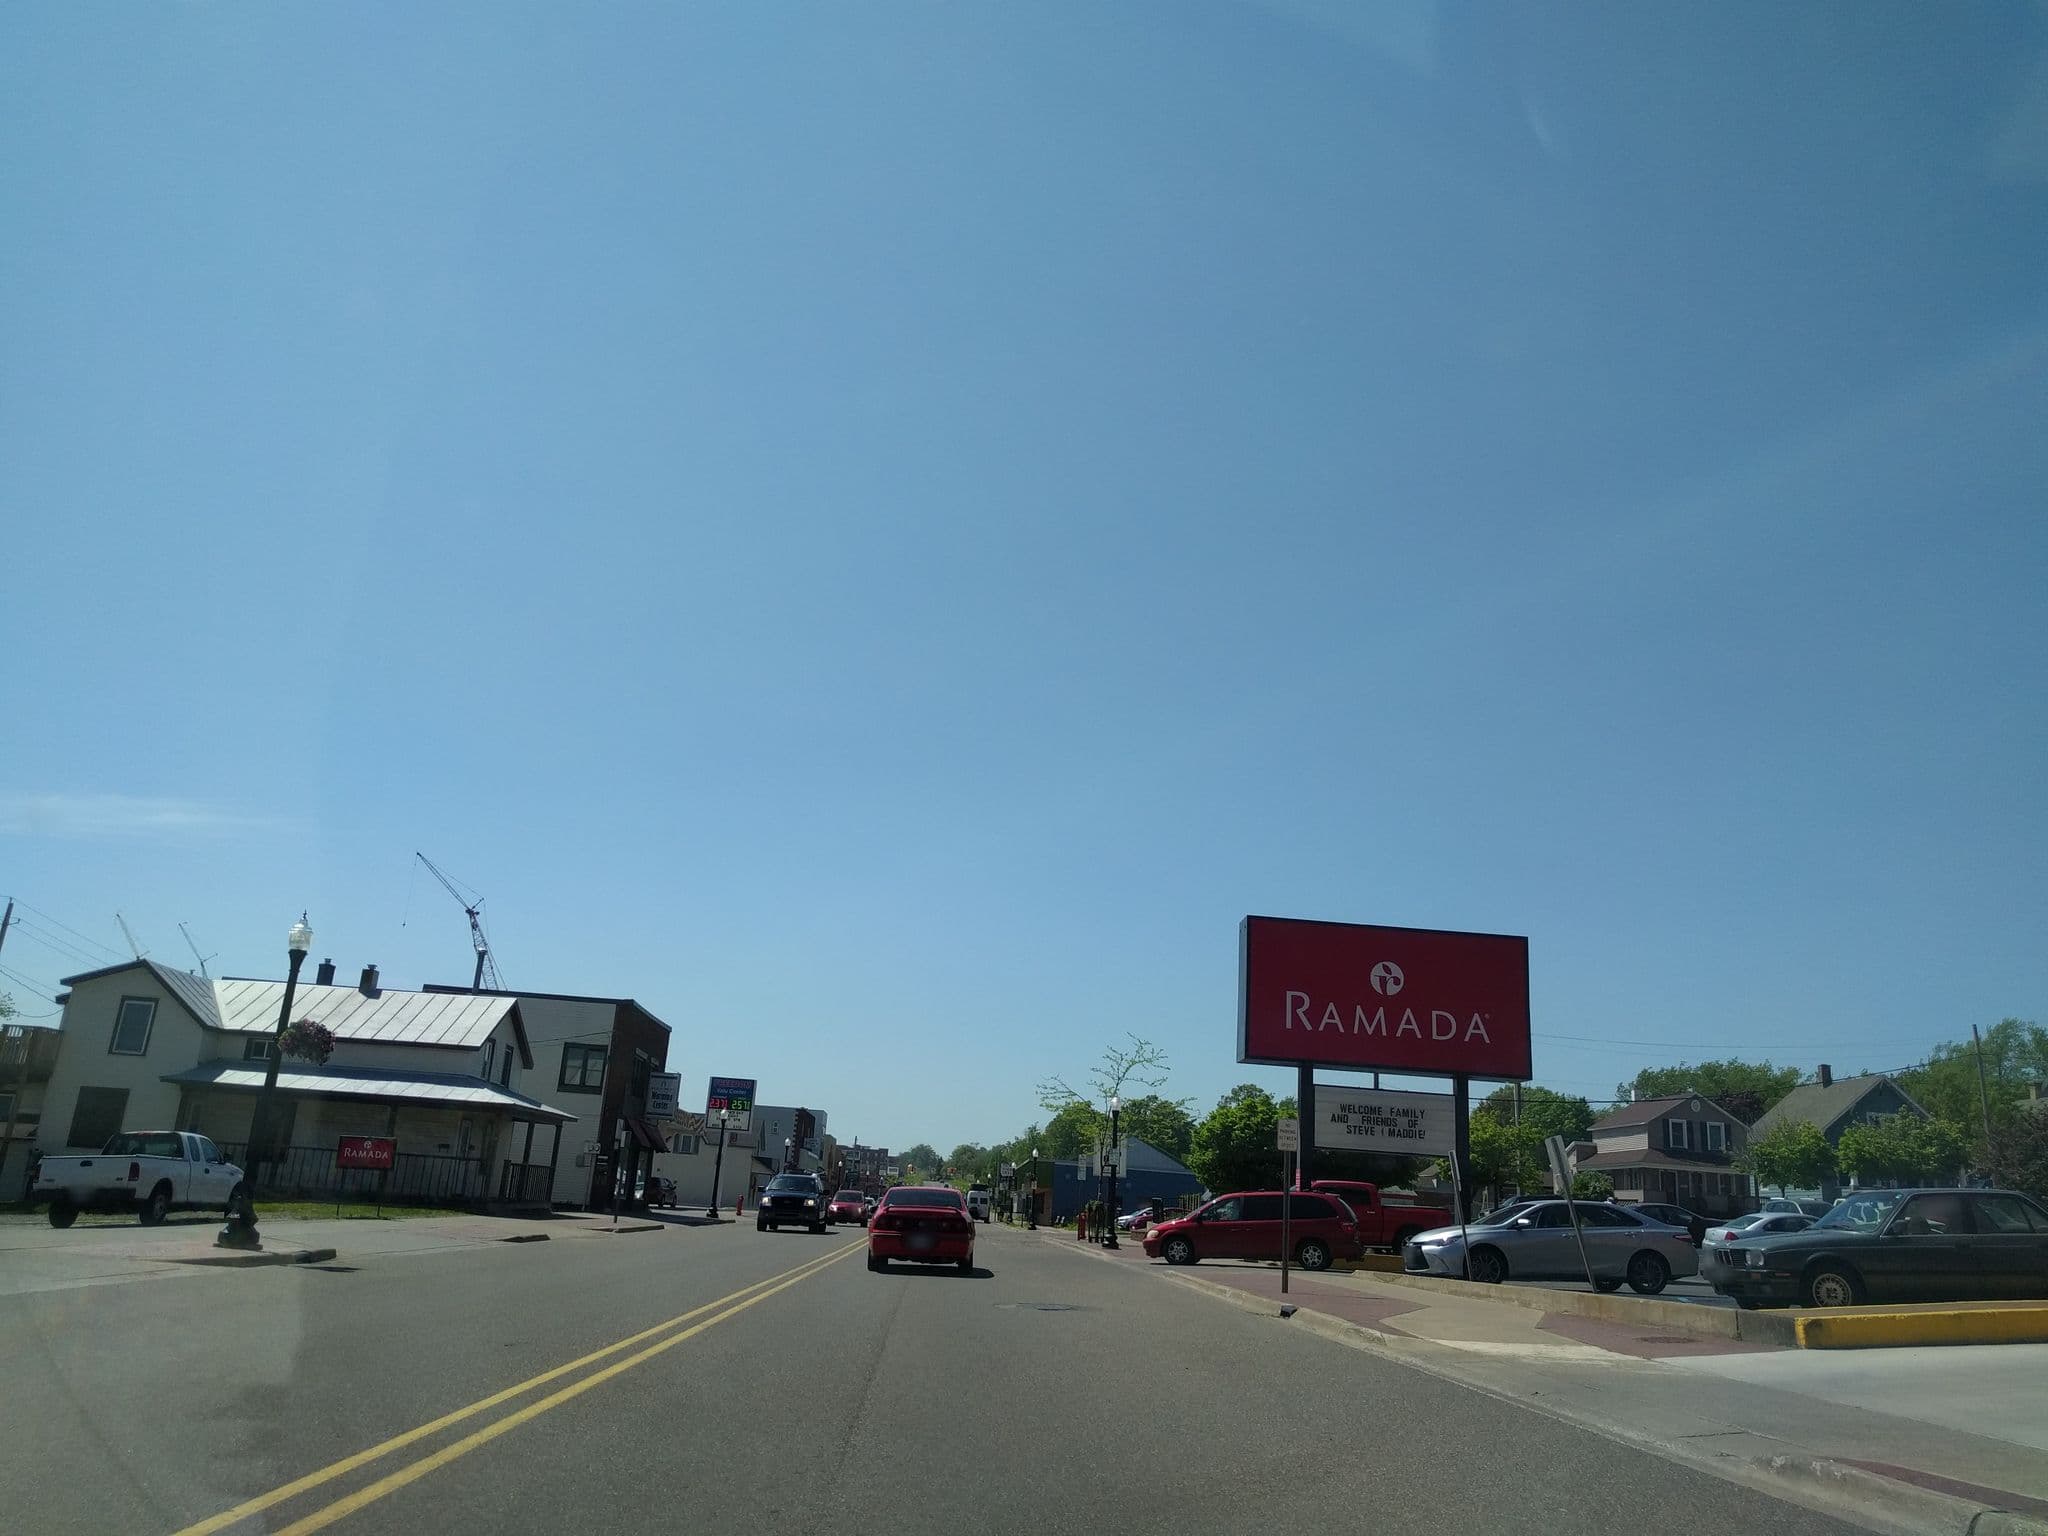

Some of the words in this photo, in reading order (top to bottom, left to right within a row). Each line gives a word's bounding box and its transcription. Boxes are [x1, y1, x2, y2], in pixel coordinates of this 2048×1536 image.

[1285, 990, 1491, 1044] RAMADA
[1339, 1103, 1382, 1116] WELCOME
[1390, 1107, 1425, 1120] FAMILY
[1330, 1113, 1349, 1124] AND
[1361, 1115, 1398, 1128] FRIENDS
[1407, 1119, 1419, 1129] OF
[1346, 1125, 1375, 1136] STEVE
[344, 1147, 389, 1160] RAMADA
